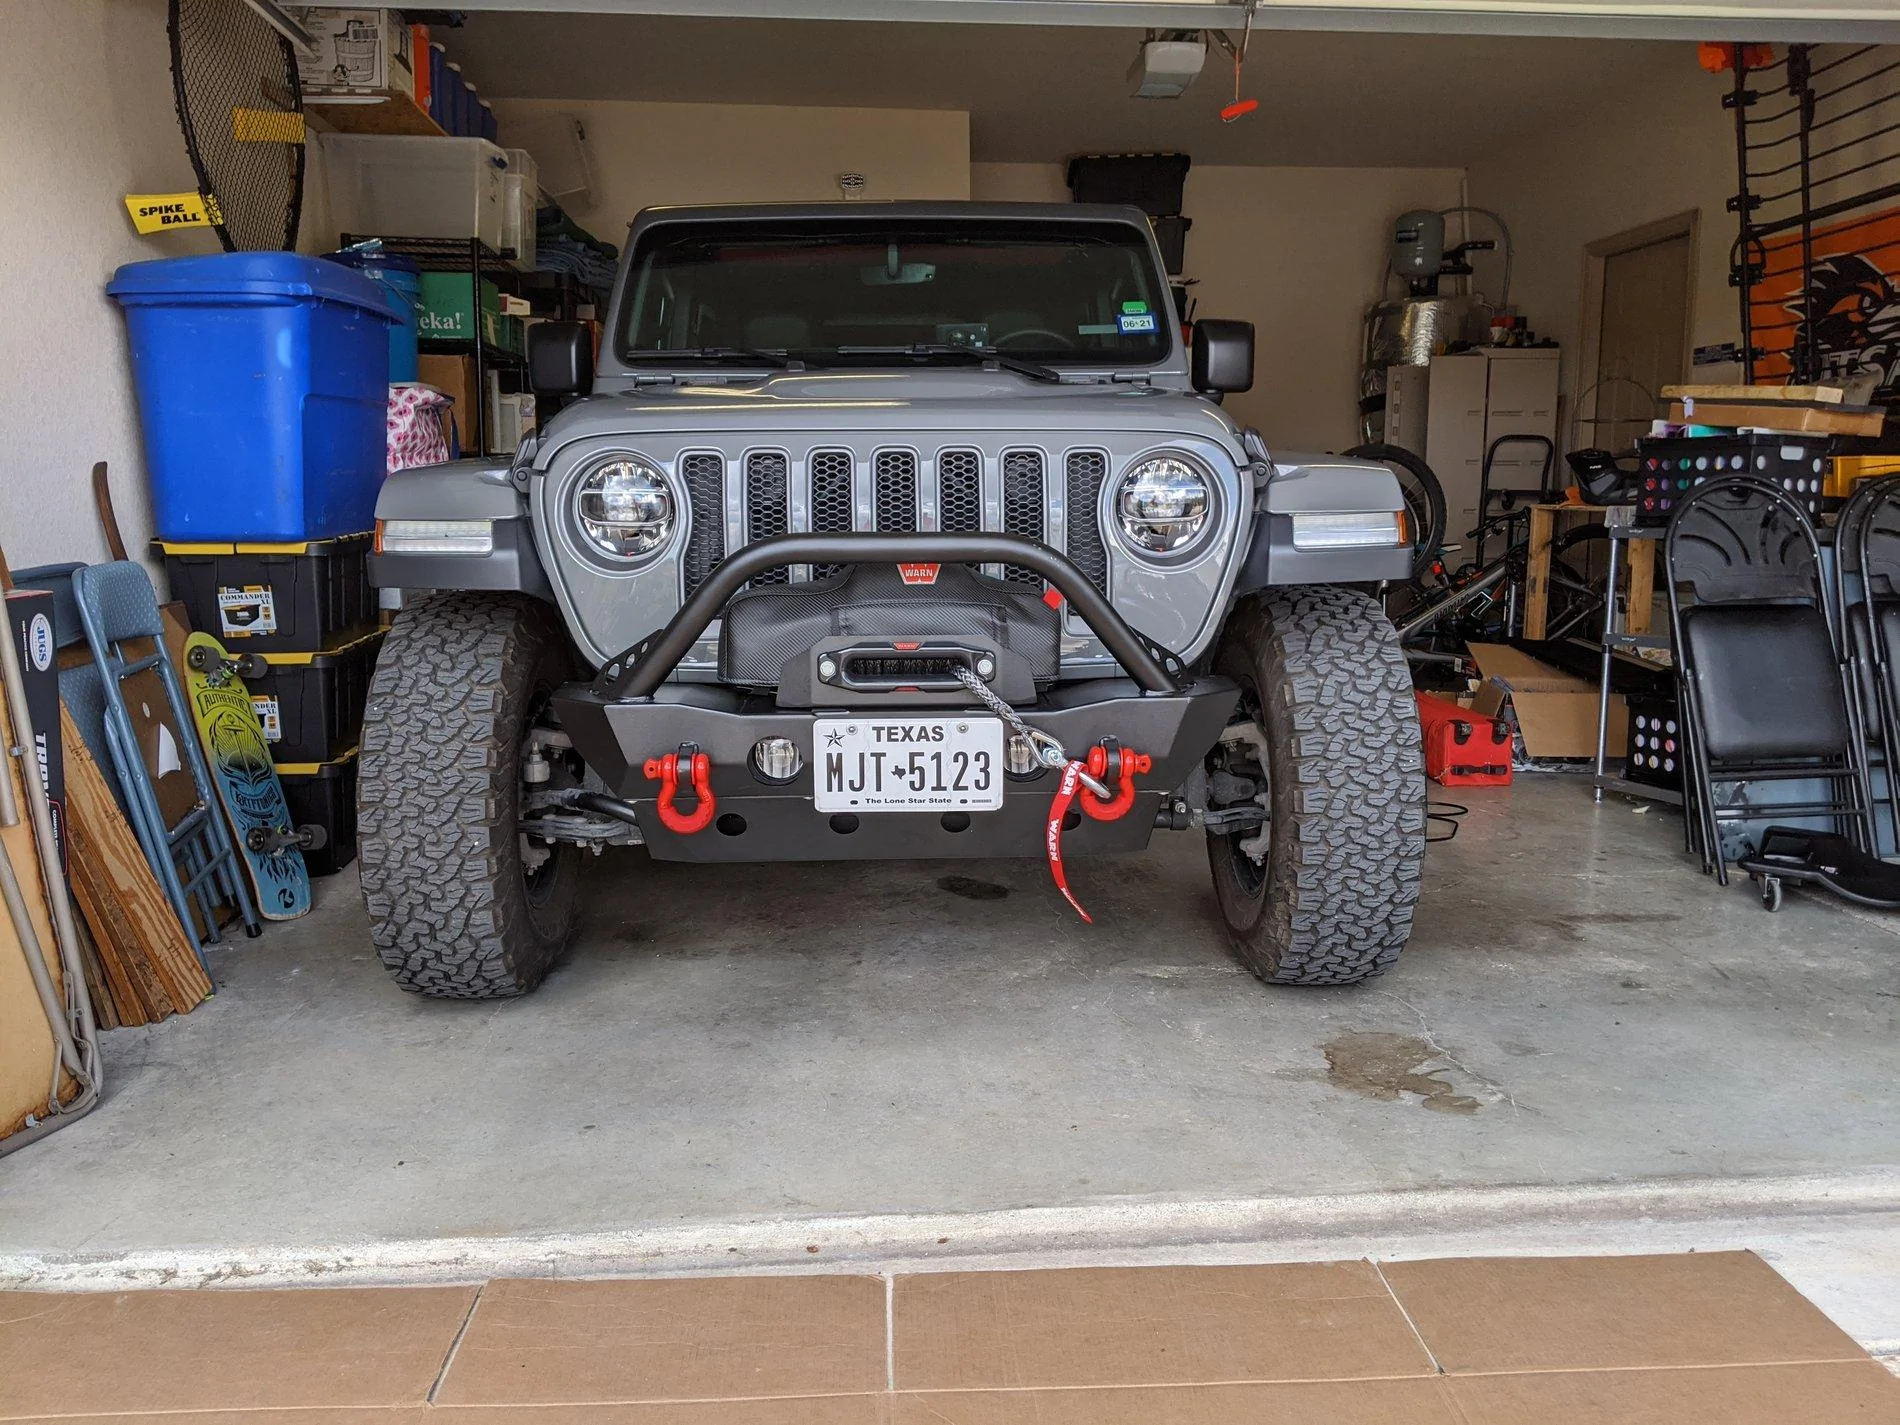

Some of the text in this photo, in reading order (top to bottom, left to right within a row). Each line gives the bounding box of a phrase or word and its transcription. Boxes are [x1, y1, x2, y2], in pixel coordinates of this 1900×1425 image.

[139, 204, 185, 216] SPIKE
[161, 213, 201, 224] BALL
[419, 311, 462, 329] eka!
[905, 569, 933, 577] WARN
[220, 593, 270, 601] COMMANDER
[37, 626, 47, 662] JUGS
[204, 693, 248, 714] AUTHENTIC
[872, 725, 944, 743] TEXAS
[826, 751, 991, 792] MJT 5123
[1061, 760, 1084, 796] WARN
[1048, 818, 1060, 862] WARN
